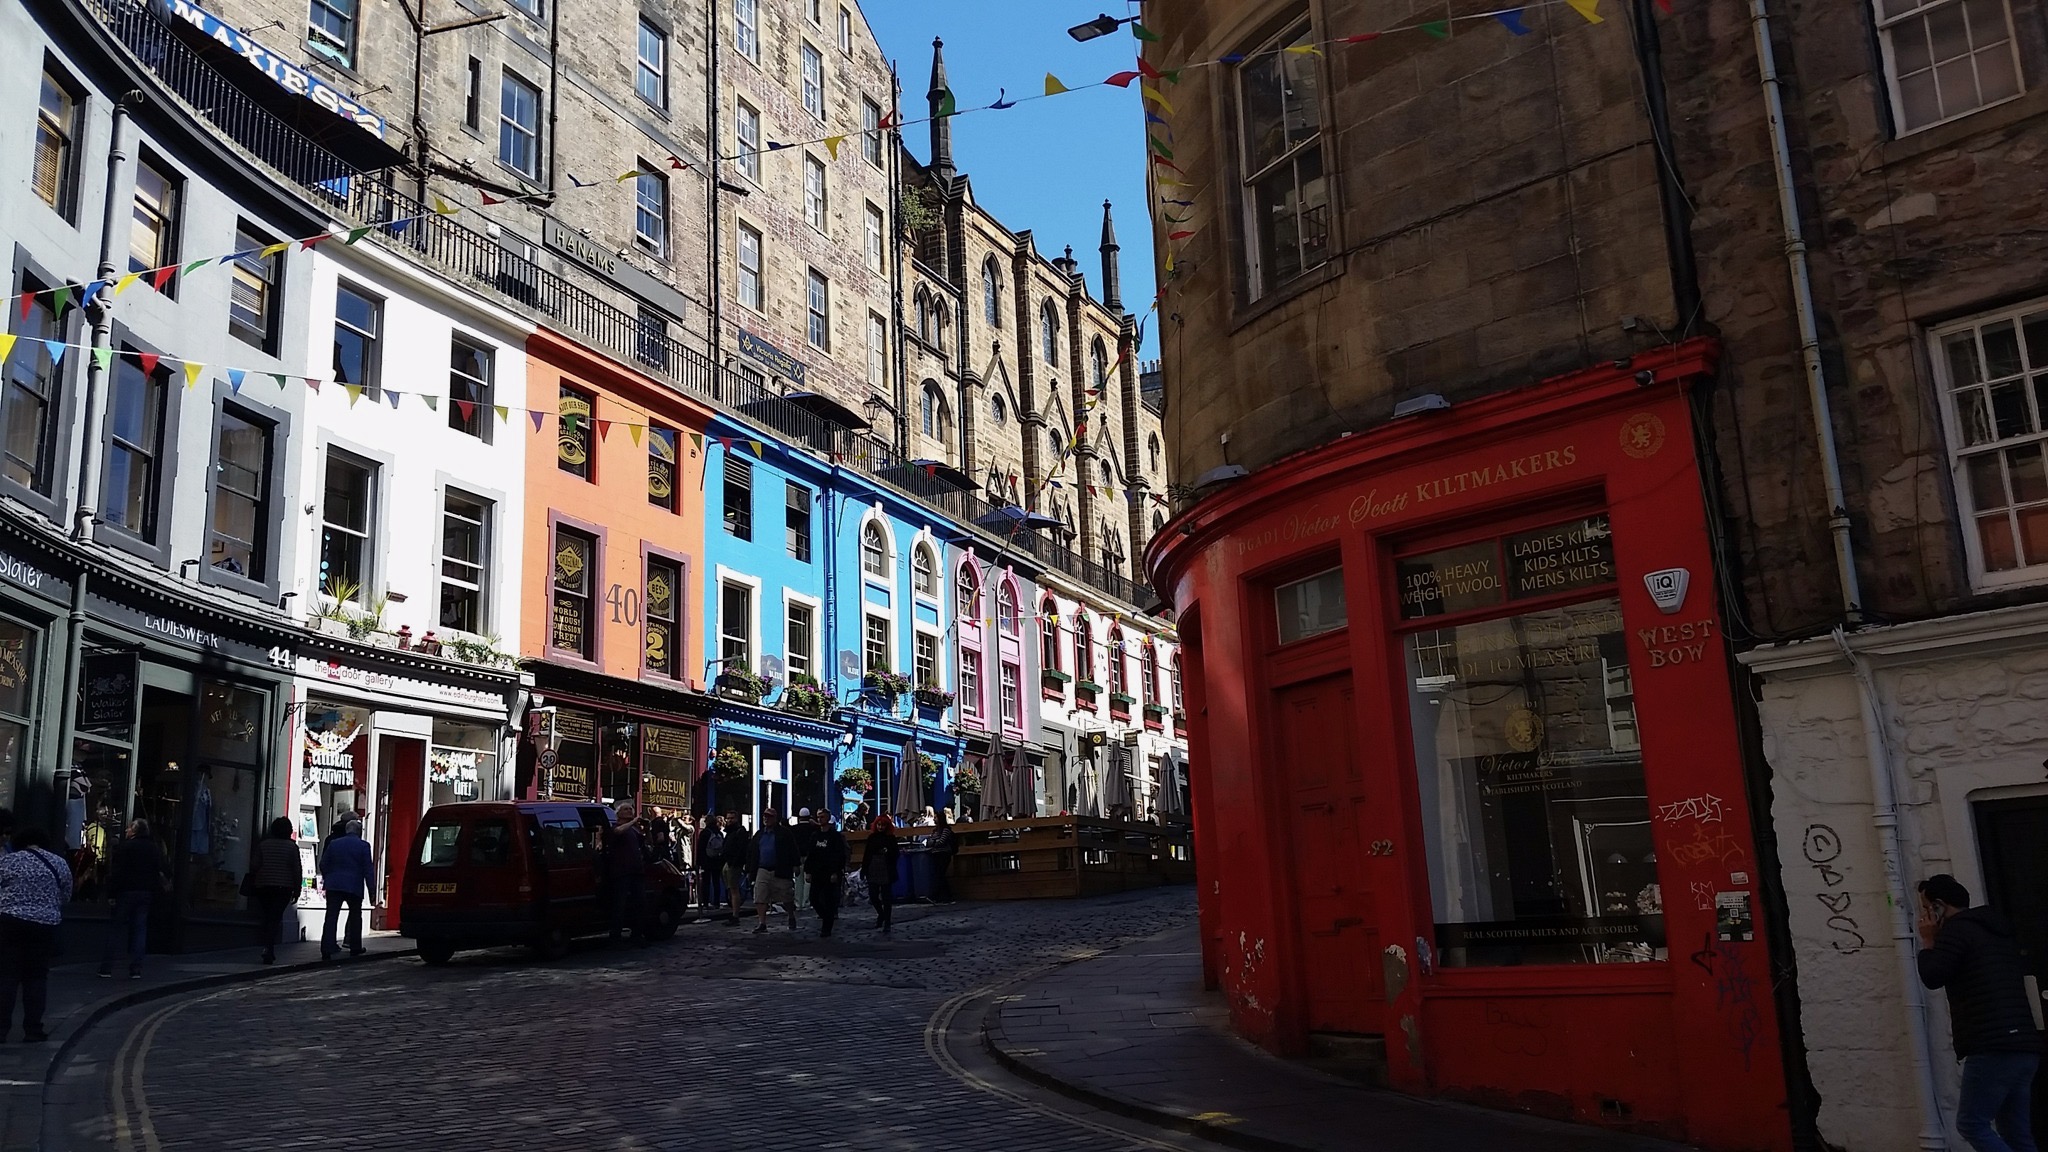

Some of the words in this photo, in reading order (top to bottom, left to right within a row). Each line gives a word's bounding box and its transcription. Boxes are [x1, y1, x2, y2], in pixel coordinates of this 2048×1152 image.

[555, 228, 616, 275] HANAMS
[1283, 504, 1340, 542] Victor
[1348, 489, 1408, 529] Scott
[1415, 445, 1576, 503] KILTMAKERS
[1513, 535, 1564, 558] LADIES
[1523, 554, 1557, 573] KIDS
[1561, 544, 1600, 565] KILTS
[1406, 569, 1441, 589] 100%
[1445, 560, 1490, 581] HEAVY
[1521, 570, 1566, 592] MENS
[1569, 561, 1609, 582] KILTS
[1656, 576, 1672, 589] iQ
[652, 584, 665, 596] BEST
[1401, 584, 1453, 606] WEIGHT
[1456, 575, 1502, 595] WOOL
[553, 607, 578, 618] WORLD
[606, 584, 638, 627] 40
[554, 615, 580, 627] AMOUS!
[553, 631, 577, 643] FREE!
[1637, 619, 1713, 649] WEST
[646, 632, 664, 660] 2
[1649, 641, 1706, 668] BOW
[314, 662, 327, 674] the
[328, 666, 340, 677] red
[342, 667, 360, 681] door
[365, 673, 394, 688] gallery
[91, 699, 129, 709] Walker
[1480, 750, 1530, 774] Victor
[1506, 769, 1554, 781] KILTMAKERS
[552, 781, 580, 794] CONTEXT
[649, 779, 686, 798] MUSEUM
[1532, 783, 1541, 792] IN
[1542, 781, 1583, 792] SCOTLAND
[656, 795, 680, 806] CONTEXT
[1371, 838, 1394, 856] 92
[1463, 930, 1486, 940] REAL
[1486, 928, 1529, 939] SCOTTISH
[1532, 928, 1557, 937] KILTS
[1559, 927, 1579, 936] AND
